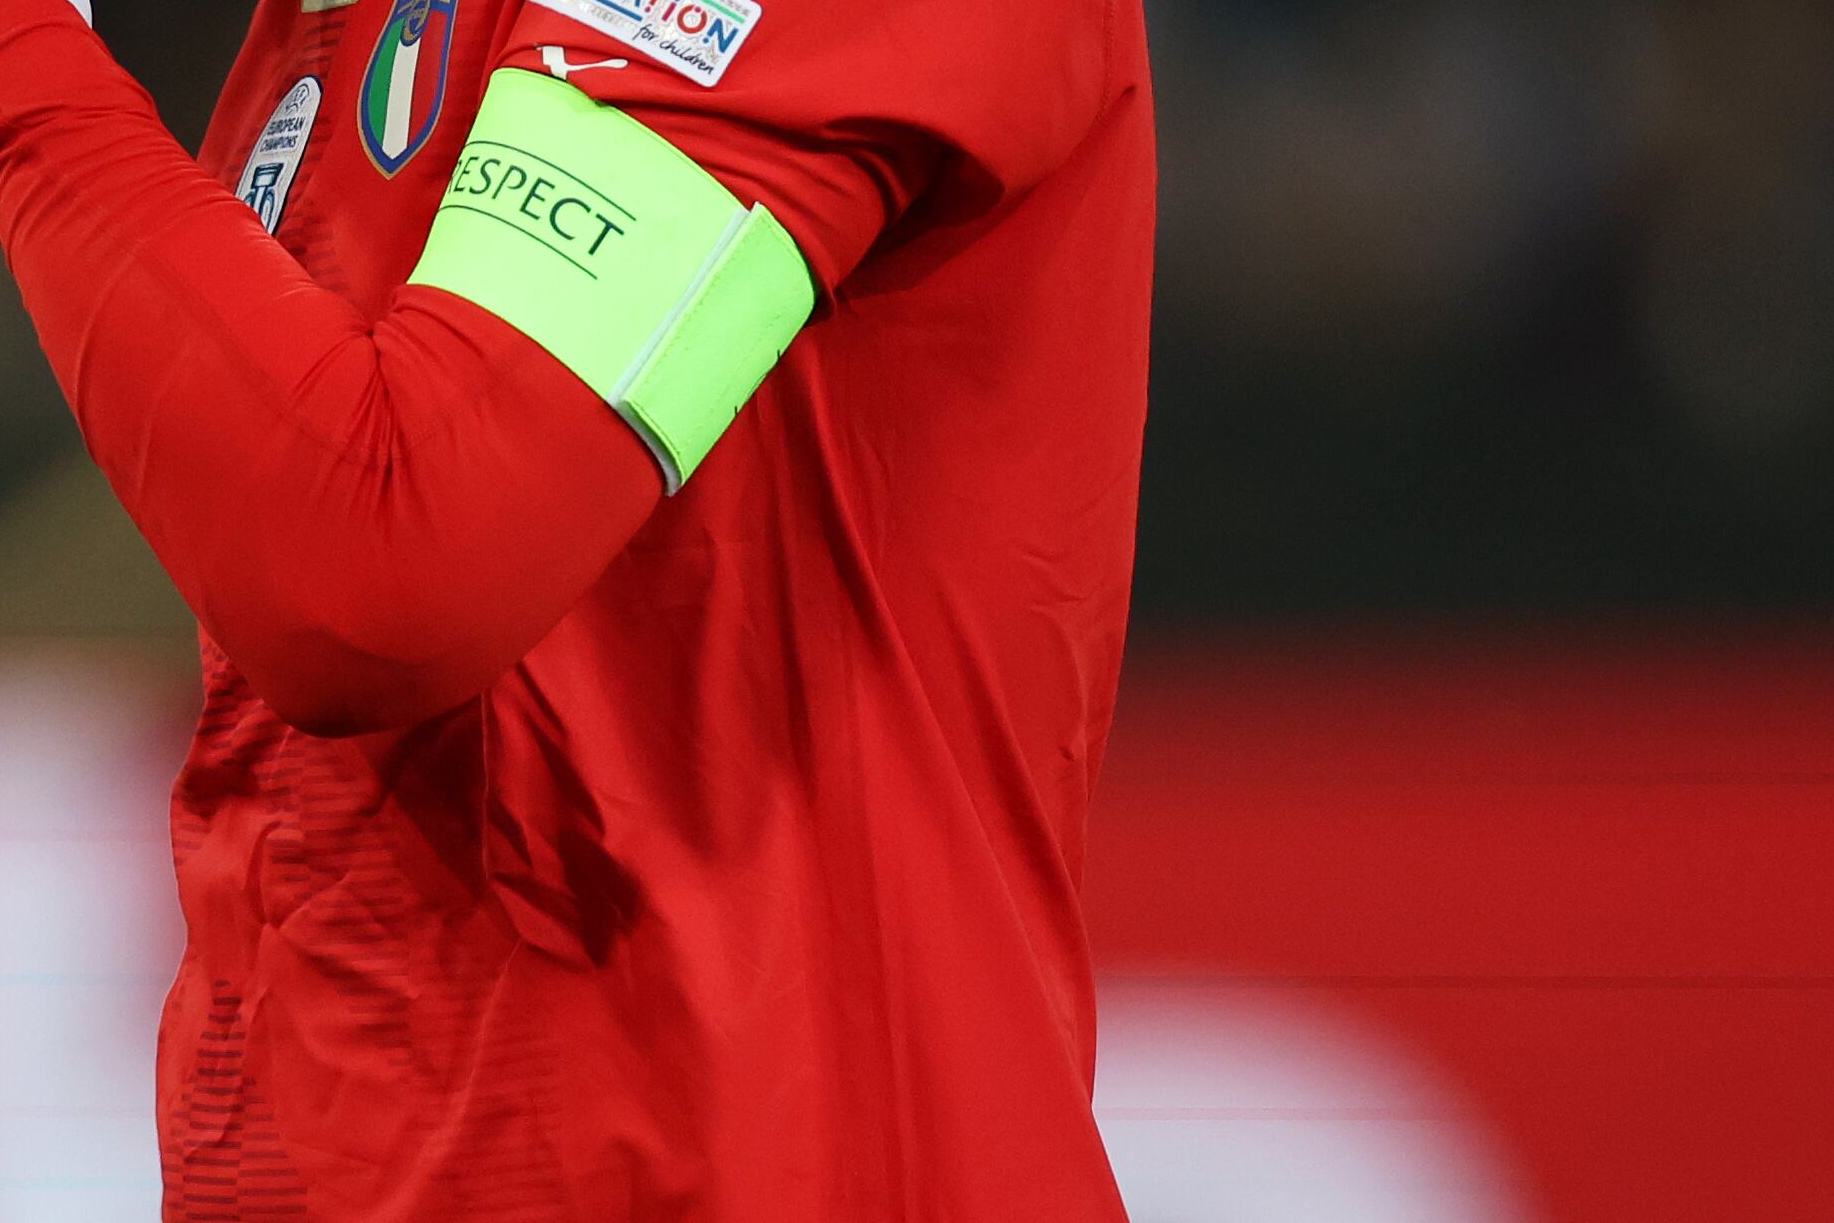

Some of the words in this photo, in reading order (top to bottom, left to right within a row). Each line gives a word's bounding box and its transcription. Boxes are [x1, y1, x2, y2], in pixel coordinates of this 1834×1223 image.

[633, 23, 656, 48] for
[659, 39, 715, 75] children
[267, 116, 305, 135] EUROPEAN
